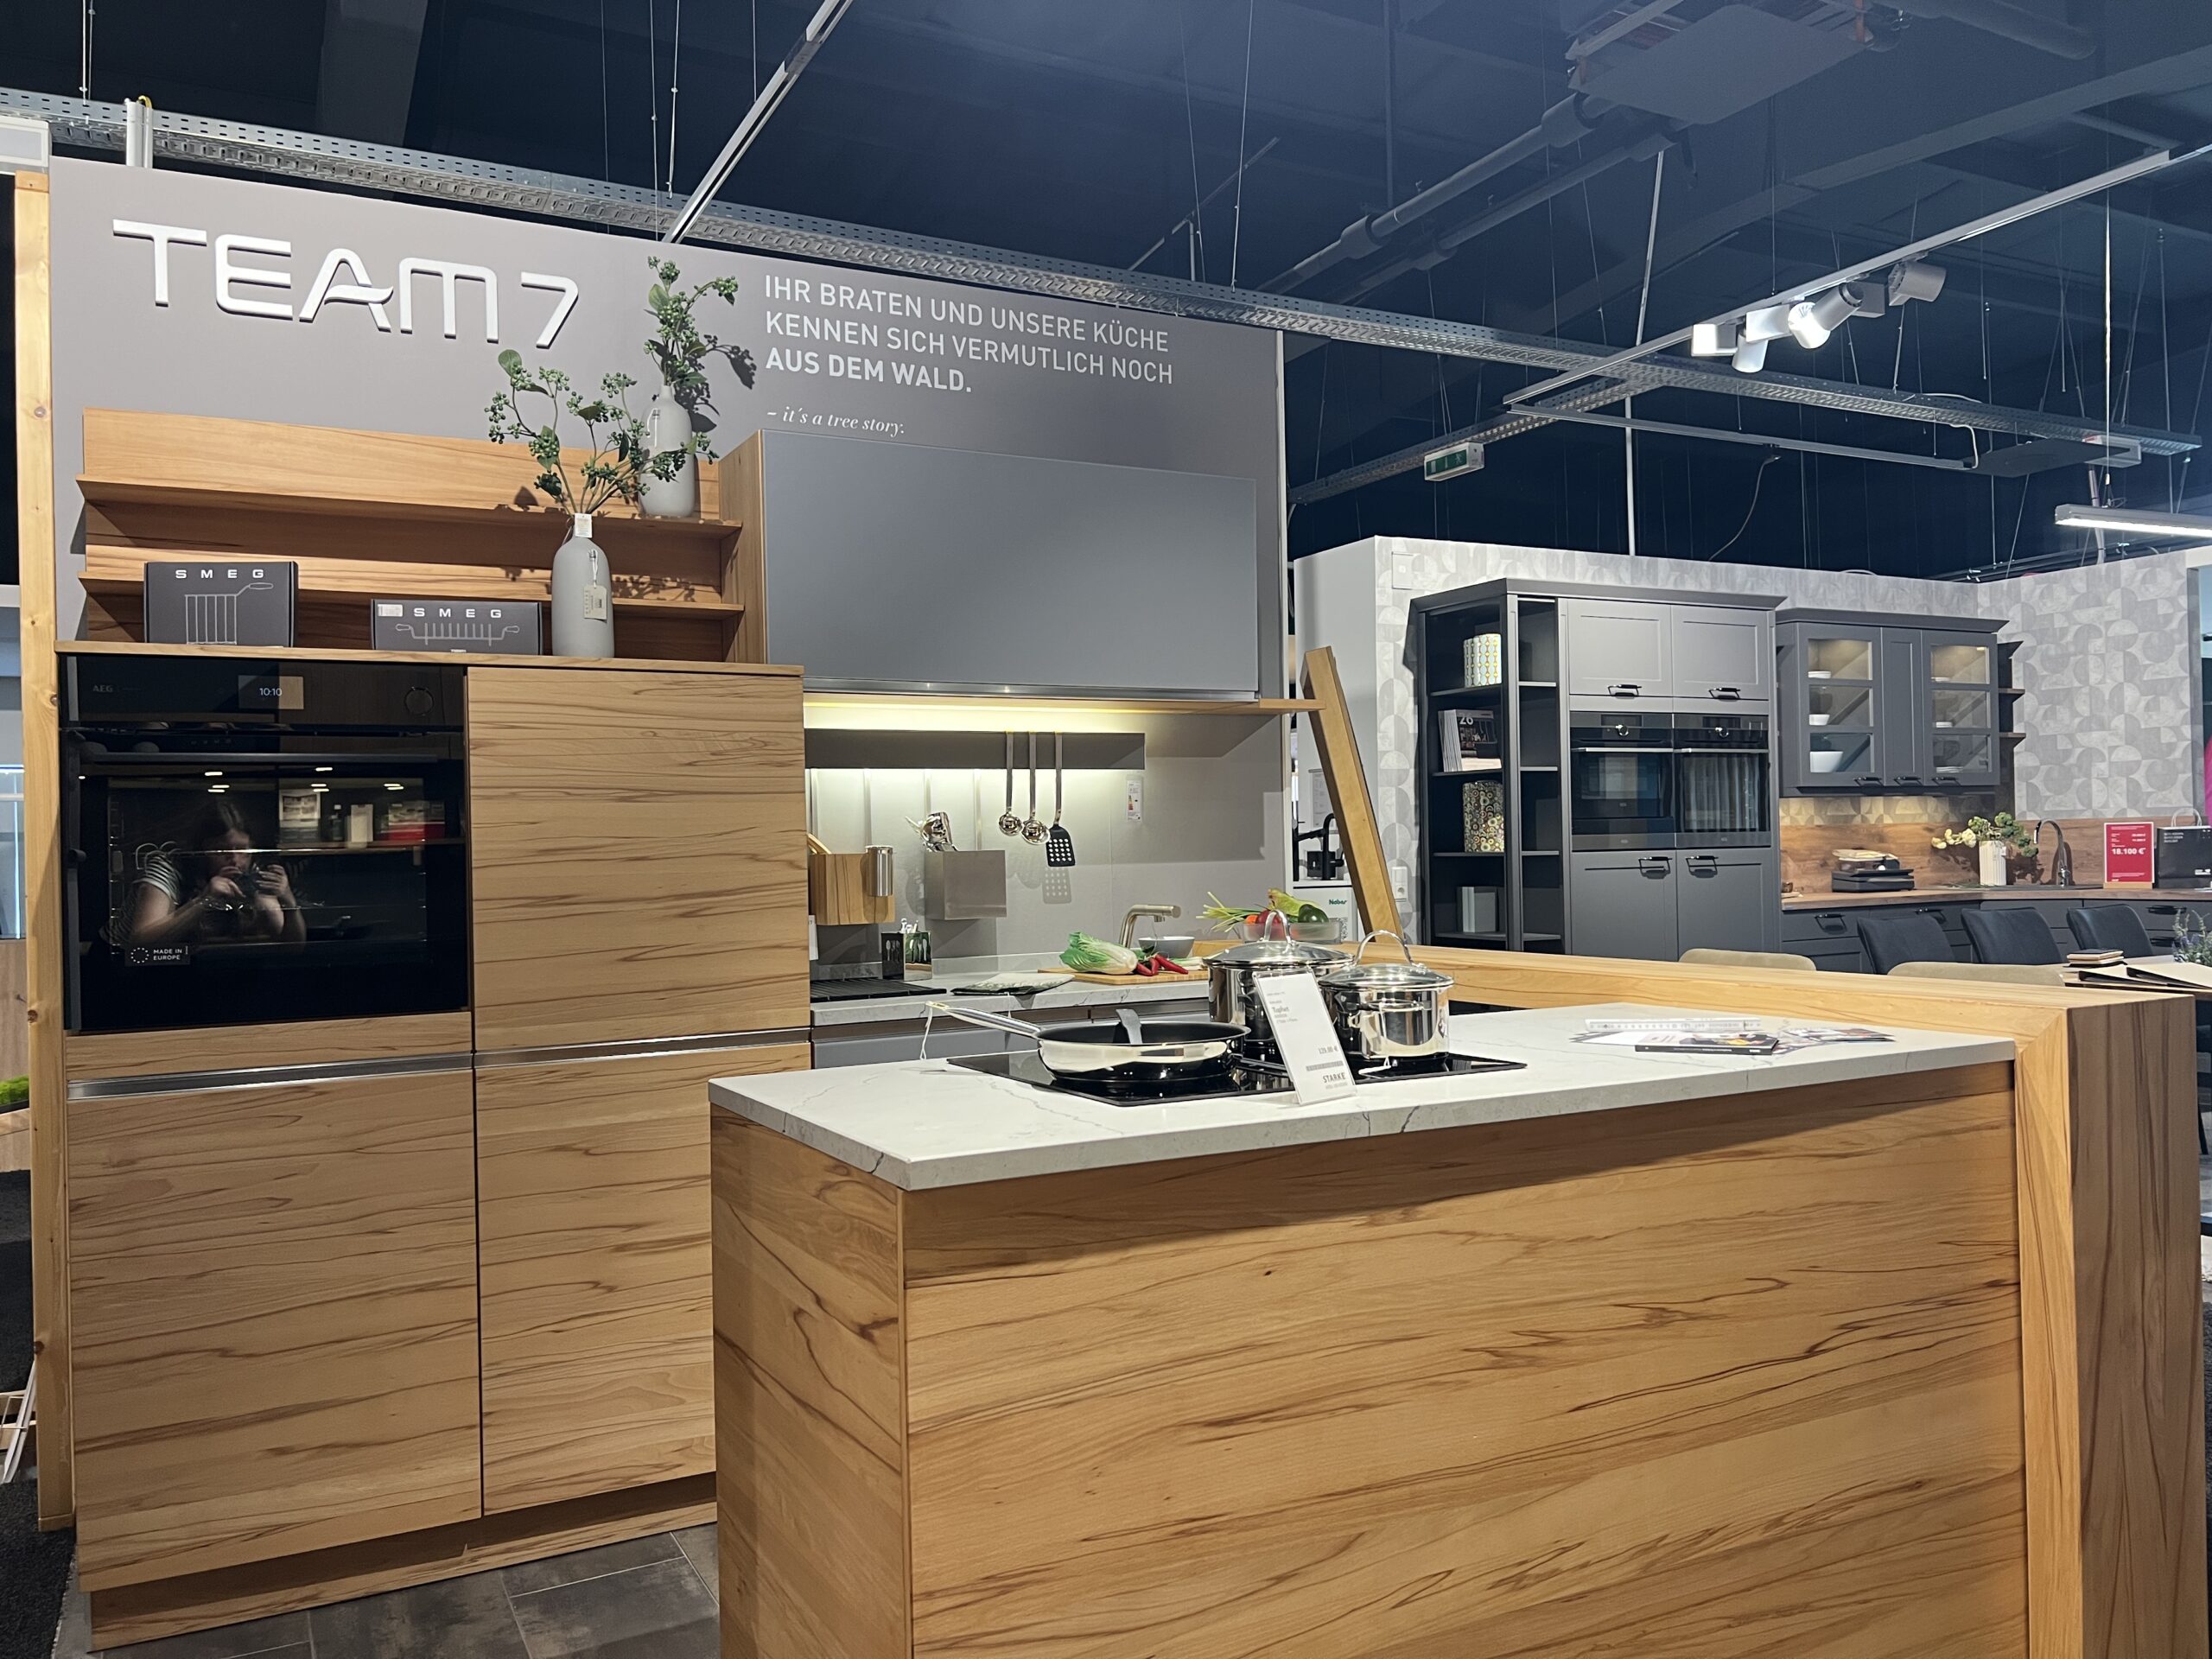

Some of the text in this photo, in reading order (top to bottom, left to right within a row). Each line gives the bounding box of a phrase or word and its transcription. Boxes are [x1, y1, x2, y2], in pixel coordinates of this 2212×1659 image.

[112, 219, 579, 349] TEAM 7
[765, 275, 1169, 353] IHR BRATEN UND UNSERE KÜCHE
[766, 310, 1173, 385] KENNEN SICH VERMUTLICH NOCH
[765, 347, 972, 393] AUS DEM WALD.
[812, 414, 823, 425] a
[827, 414, 859, 429] tree
[861, 419, 905, 438] story.
[175, 569, 264, 579] SMEG
[413, 607, 502, 619] SMEG
[92, 684, 113, 693] AEG
[258, 687, 283, 697] 10:10
[1323, 1072, 1345, 1083] STARKE
